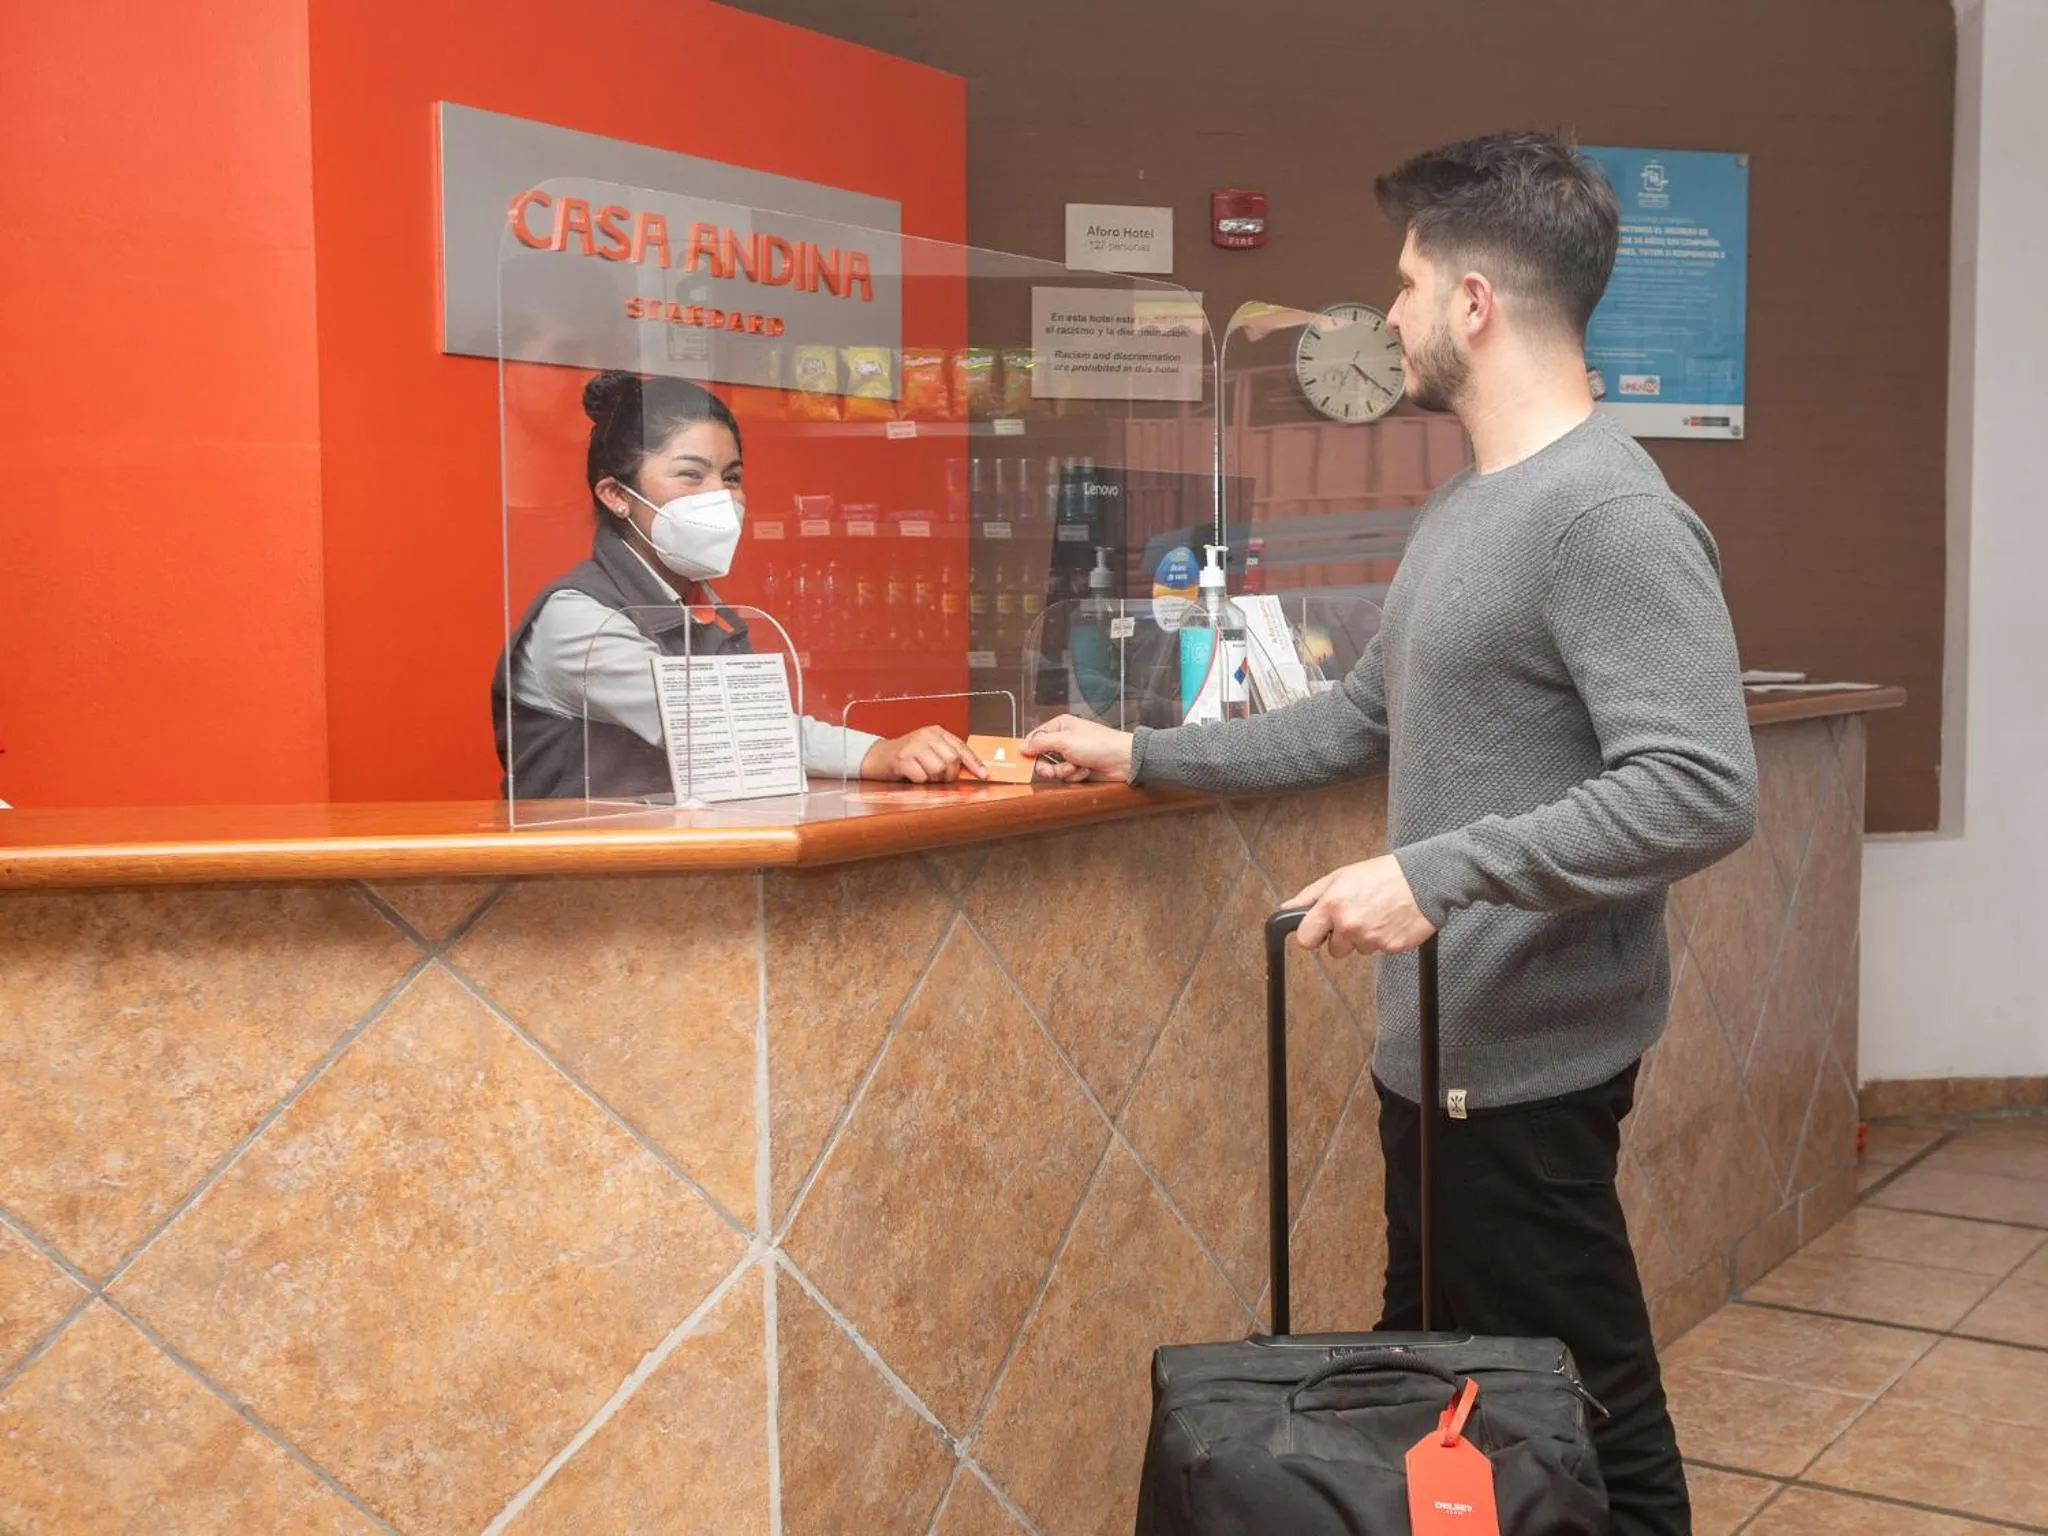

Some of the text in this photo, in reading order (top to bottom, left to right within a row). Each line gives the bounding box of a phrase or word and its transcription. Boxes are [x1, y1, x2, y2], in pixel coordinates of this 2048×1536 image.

[1087, 225, 1155, 239] Aforo Hotel
[507, 189, 873, 302] CASA ANDINA
[624, 296, 784, 337] STANDARD
[1051, 312, 1064, 322] En
[1089, 314, 1114, 323] hotel
[1057, 327, 1096, 336] racismo
[1097, 328, 1104, 337] y
[1106, 327, 1115, 336] la
[1055, 350, 1181, 362] Racism and discrimination
[1071, 363, 1121, 374] prohibited
[1083, 481, 1119, 497] Lenovo
[1434, 1501, 1472, 1513] DELSEY
